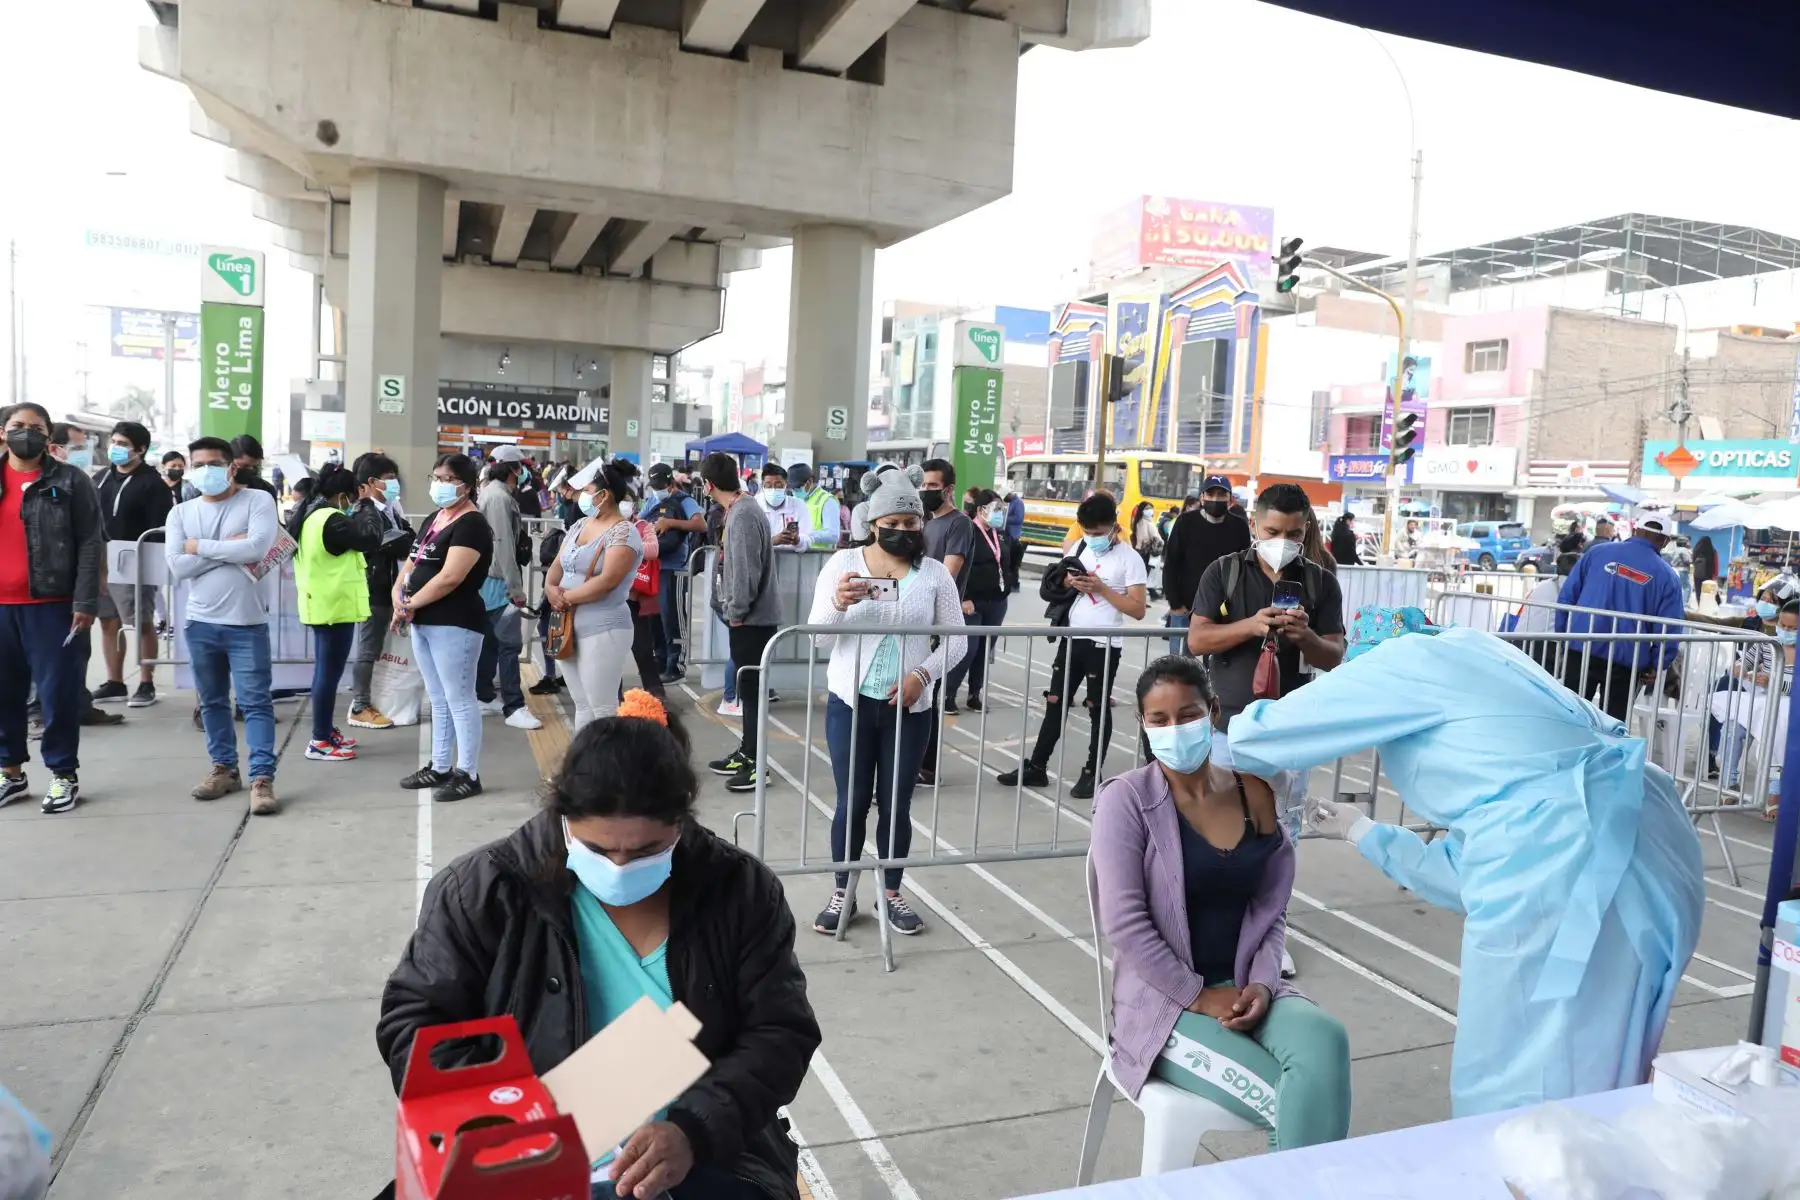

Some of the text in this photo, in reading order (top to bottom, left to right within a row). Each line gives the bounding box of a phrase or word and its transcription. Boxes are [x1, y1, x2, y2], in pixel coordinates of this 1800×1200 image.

[239, 273, 251, 294] 1
[231, 316, 253, 411] de Lima
[208, 342, 231, 410] Metro
[383, 379, 400, 397] S
[497, 401, 532, 419] LOS
[535, 403, 609, 423] JARDINE
[830, 409, 845, 426] S
[979, 378, 997, 456] de Lima
[963, 399, 981, 455] Metro
[1427, 460, 1461, 474] GMO
[1708, 449, 1791, 468] OPTICAS
[1221, 1066, 1276, 1116] didas
